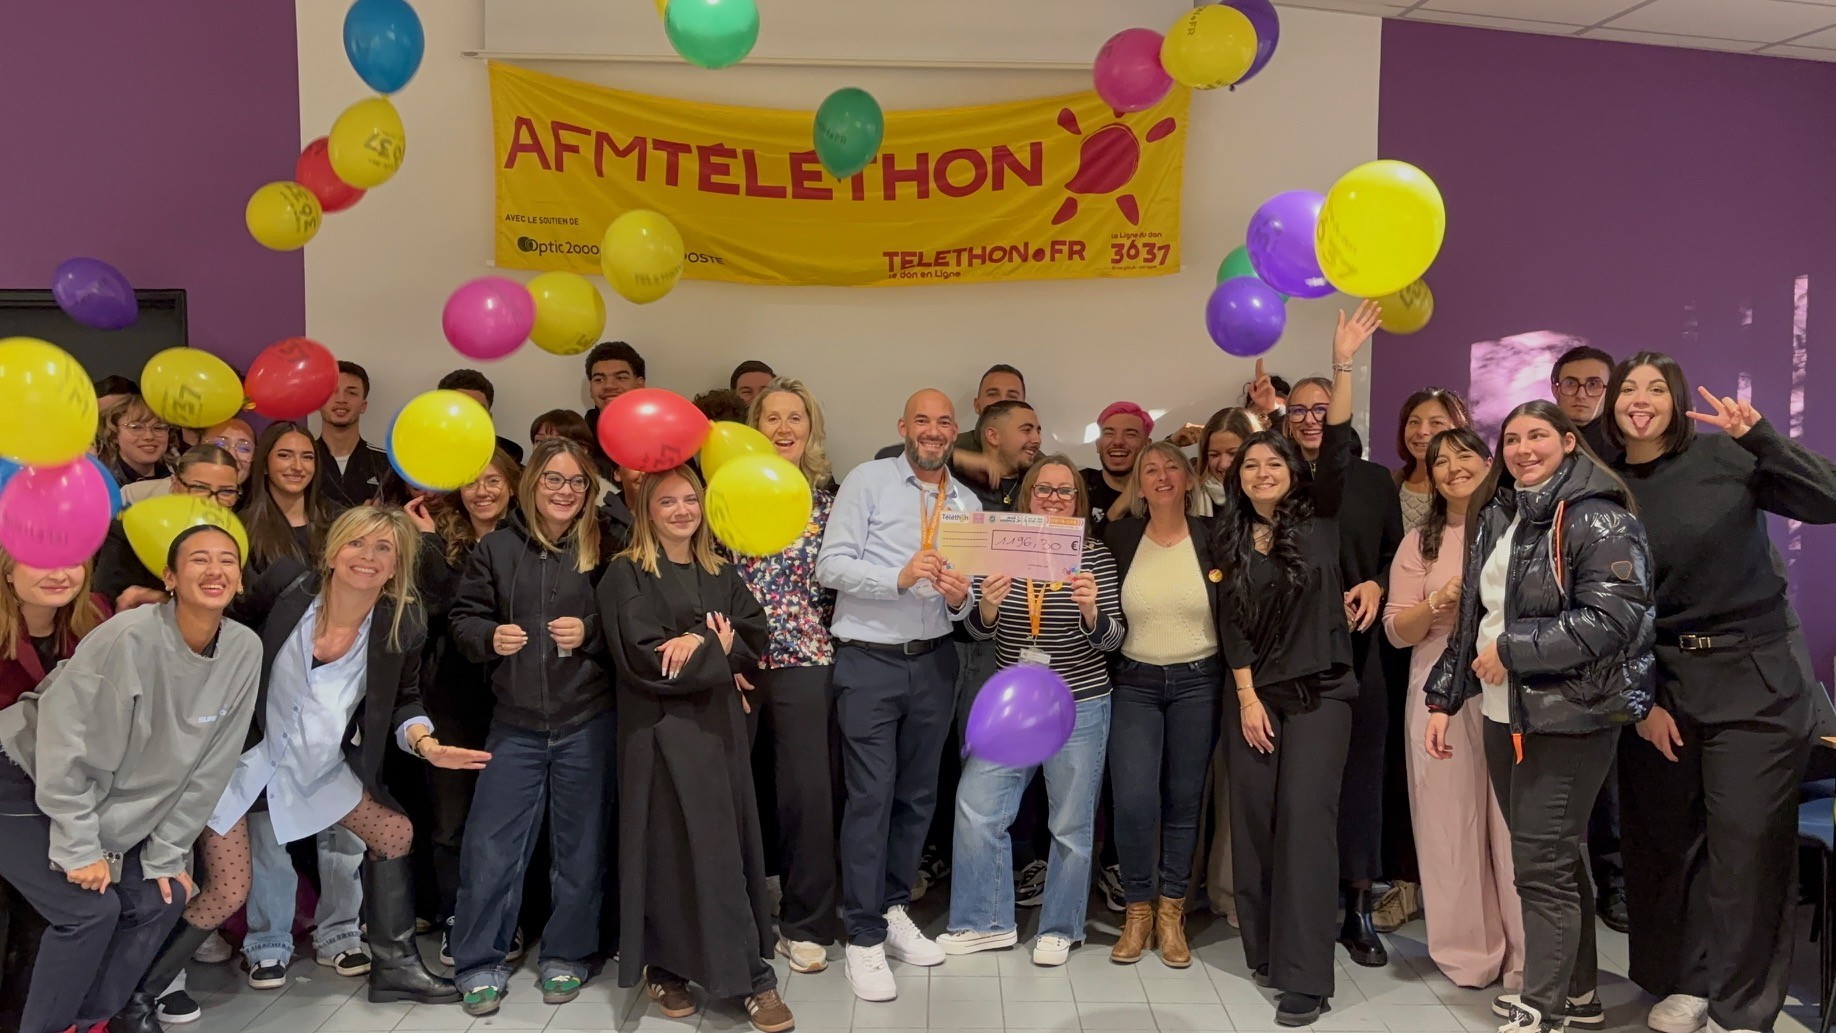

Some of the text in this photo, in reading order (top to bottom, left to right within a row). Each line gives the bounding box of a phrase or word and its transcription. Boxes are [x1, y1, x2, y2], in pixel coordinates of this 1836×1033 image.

[505, 213, 579, 226] AVEC LE SOUTIEN DE
[525, 238, 600, 256] Optic 2000
[1110, 239, 1171, 266] 3637
[899, 270, 918, 279] don
[920, 271, 933, 279] en
[1070, 540, 1079, 551] €
